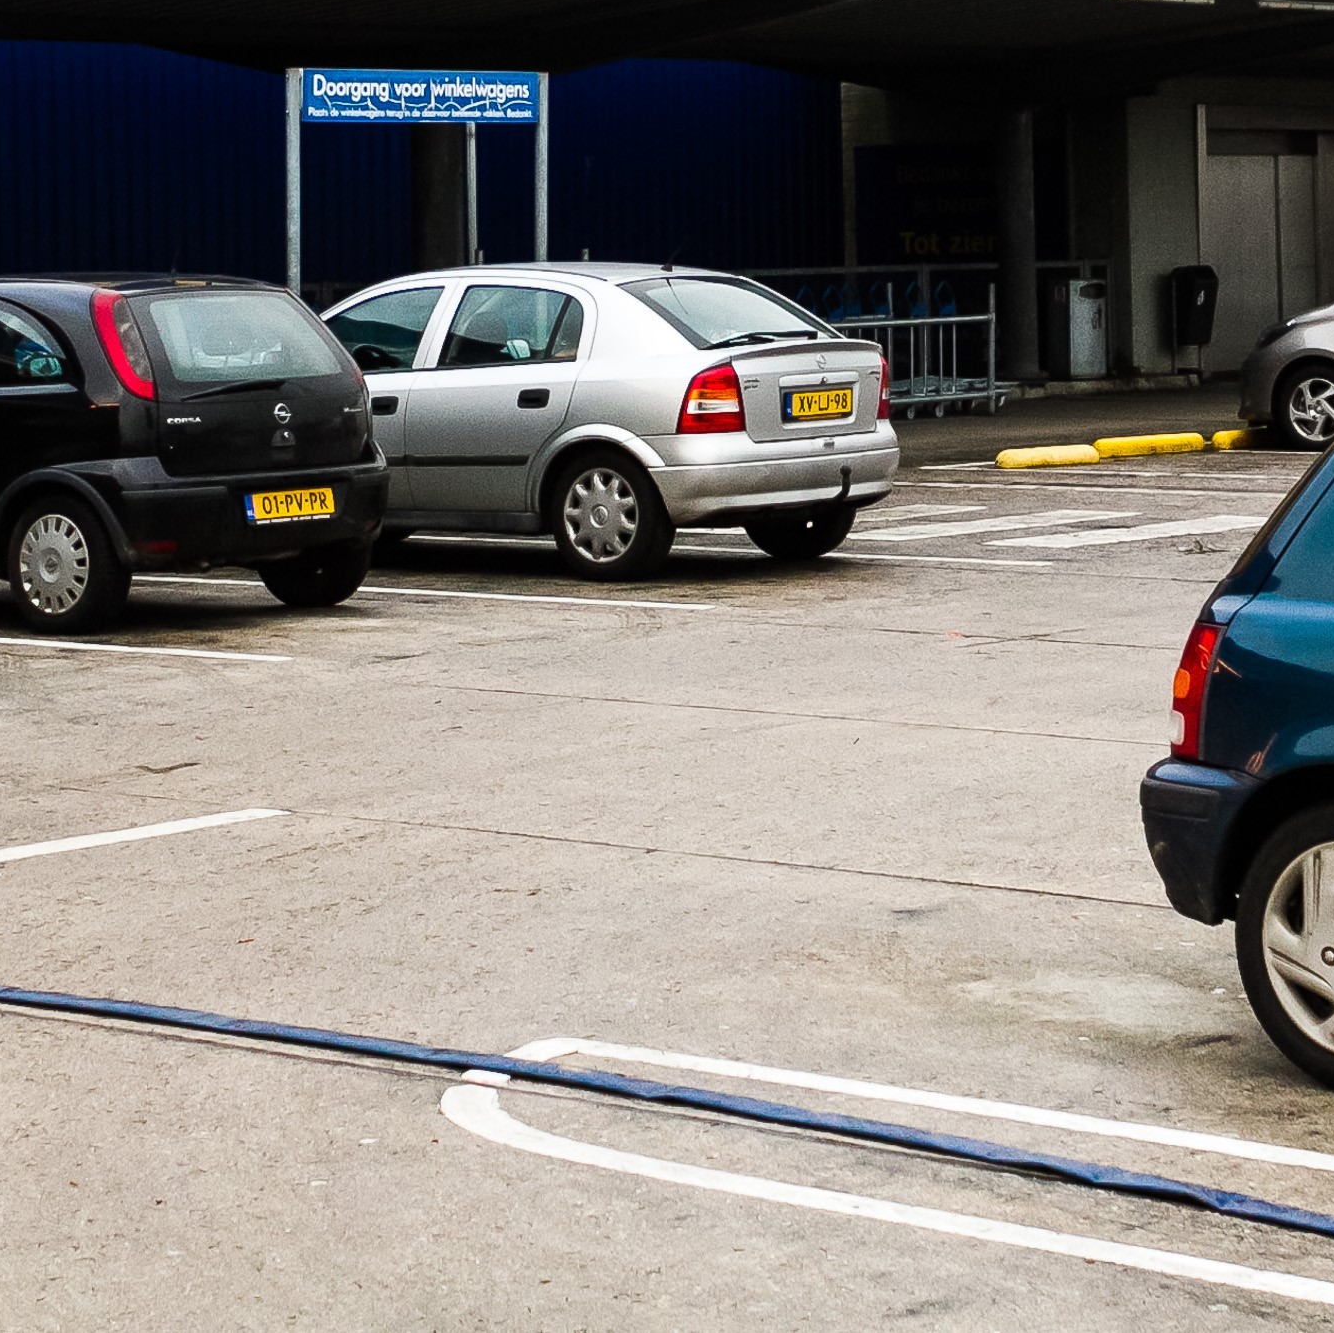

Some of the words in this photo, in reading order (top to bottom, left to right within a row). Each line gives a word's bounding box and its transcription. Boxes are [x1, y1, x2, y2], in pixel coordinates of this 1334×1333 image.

[313, 73, 389, 102] Doorgang
[394, 82, 427, 97] voor
[432, 76, 530, 103] winkelwagens
[899, 230, 941, 255] Tot
[262, 492, 329, 515] 01-PV-PR
